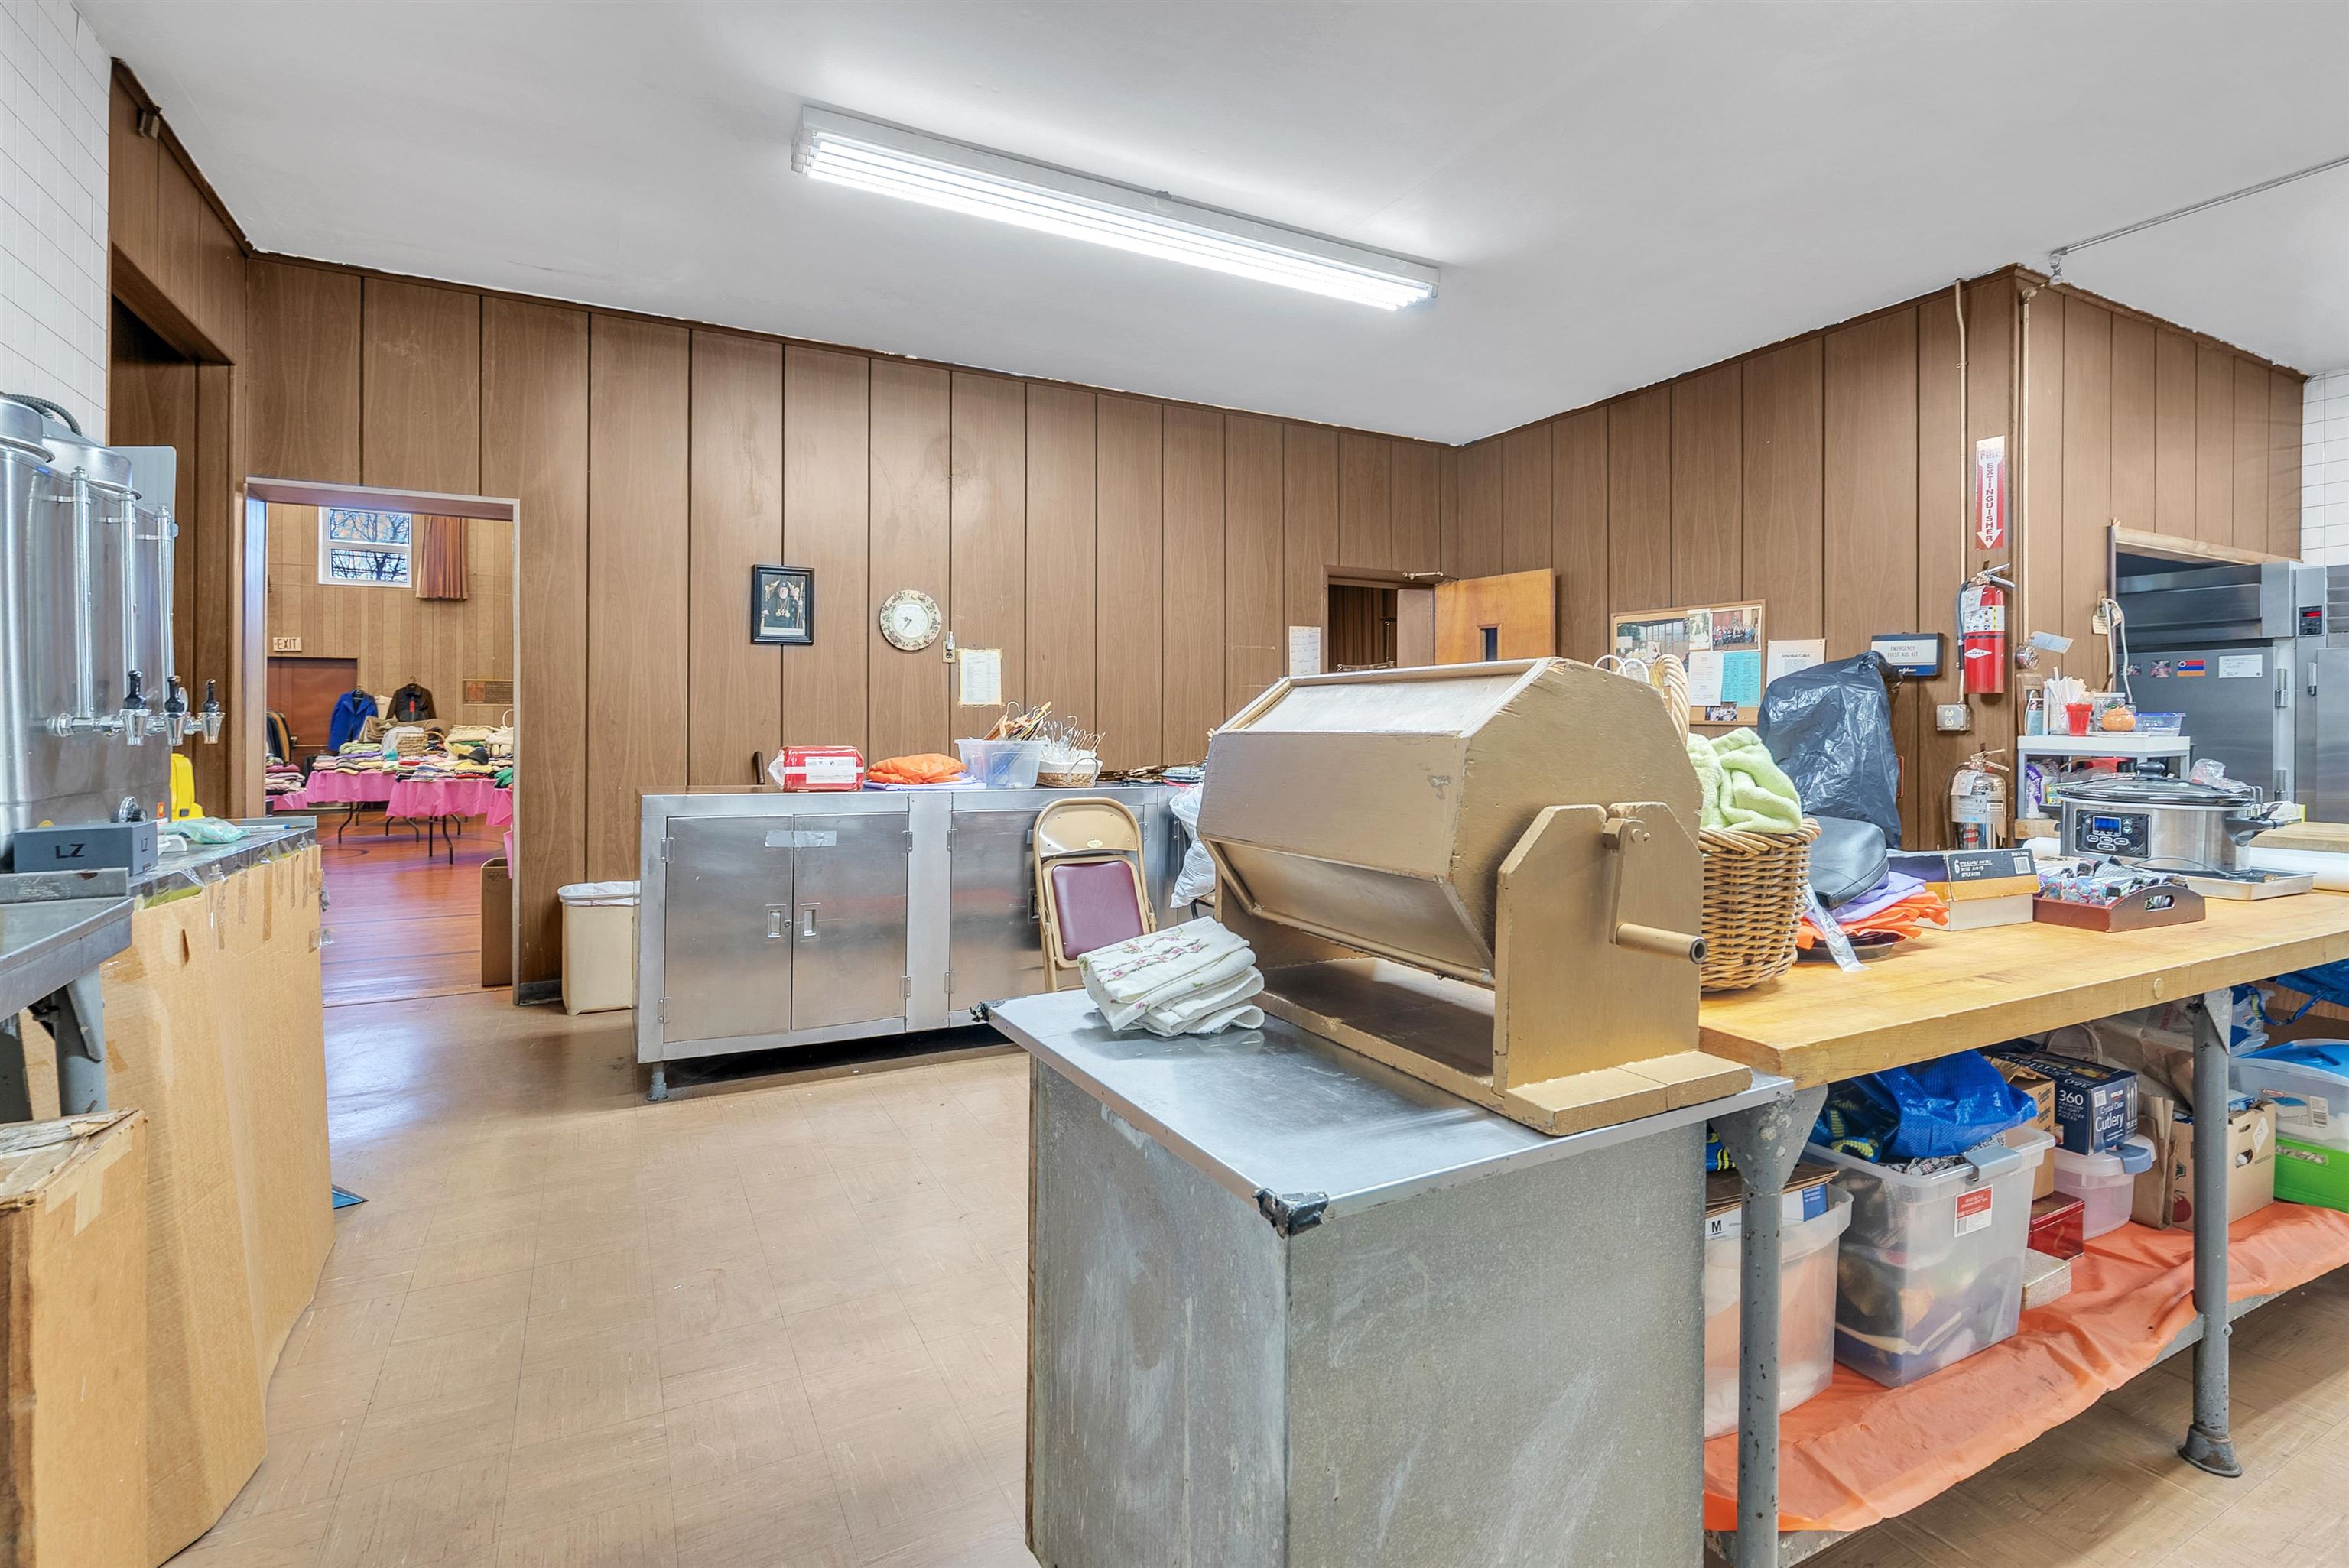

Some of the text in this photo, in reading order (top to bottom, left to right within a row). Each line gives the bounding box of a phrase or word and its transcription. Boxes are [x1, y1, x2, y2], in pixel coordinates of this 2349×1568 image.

[1986, 462, 1994, 541] EXTINGUISHER
[277, 638, 297, 650] EXIT
[55, 843, 86, 859] LZ
[1954, 859, 1960, 874] 6
[2058, 1089, 2084, 1105] 360
[2095, 1112, 2125, 1132] Cutlery
[1711, 1219, 1721, 1233] M
